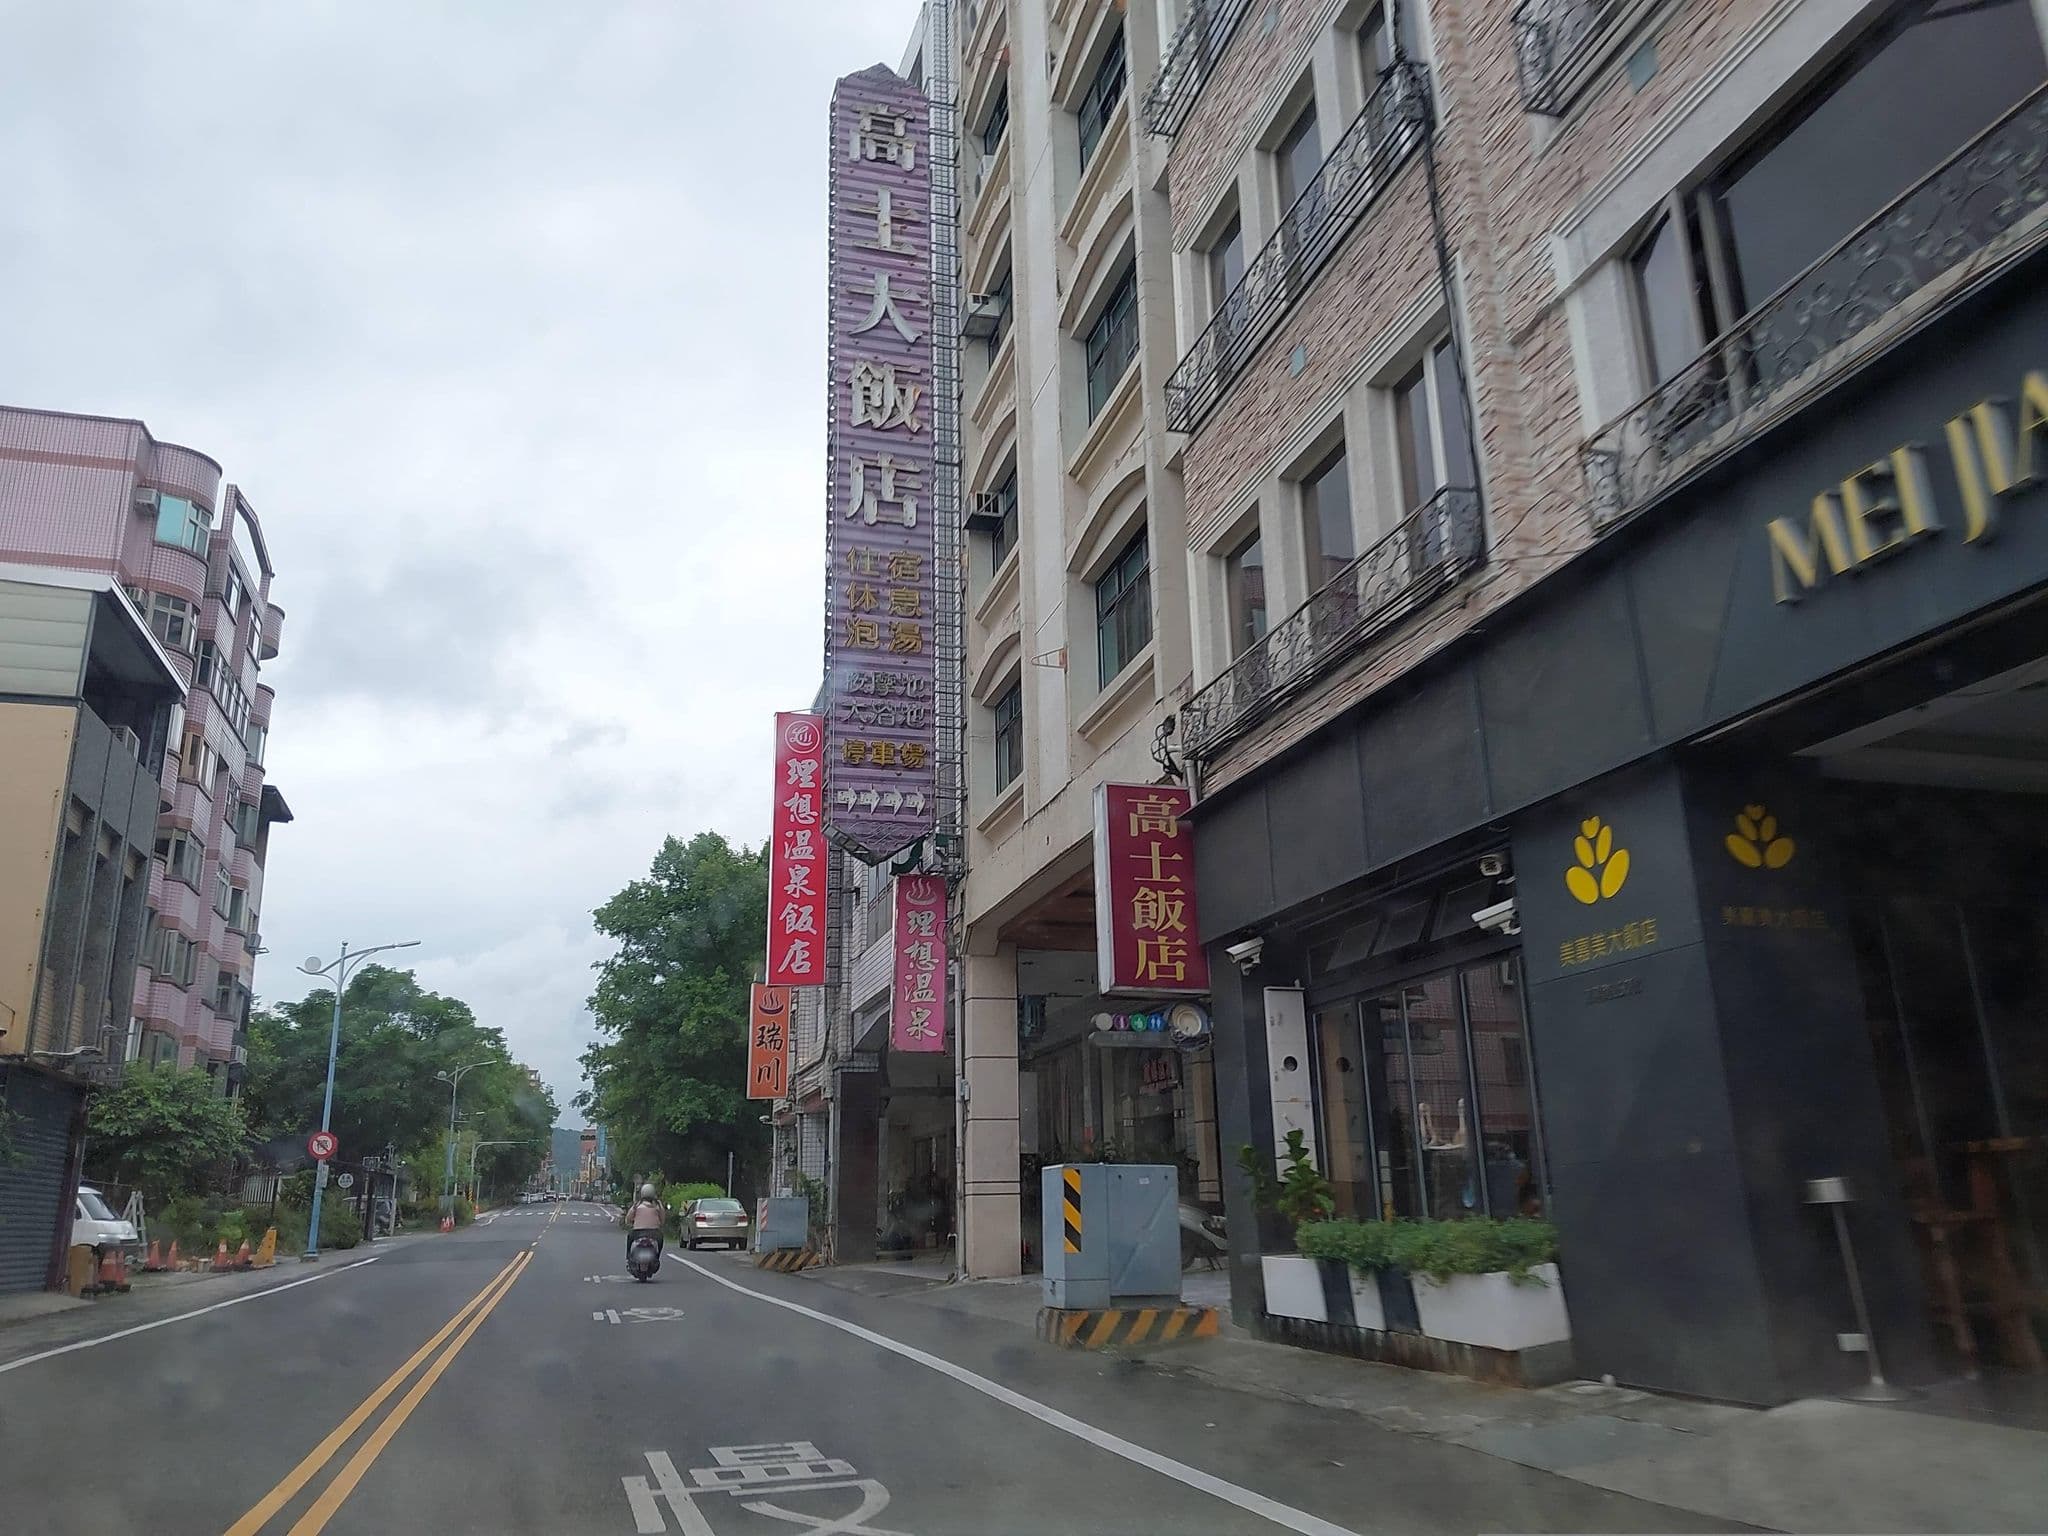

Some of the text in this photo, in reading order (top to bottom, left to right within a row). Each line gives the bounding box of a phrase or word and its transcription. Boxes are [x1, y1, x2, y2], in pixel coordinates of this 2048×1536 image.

[847, 103, 924, 528] 高士大飯店
[1768, 441, 1944, 604] MEI
[846, 545, 922, 582] 住宿
[846, 581, 922, 618] 休息
[845, 615, 923, 654] 泡湯
[841, 699, 925, 729] 大浴池
[1127, 794, 1188, 982] 高士飯店
[756, 1022, 783, 1091] 瑞川
[621, 1441, 915, 1536] 慢
